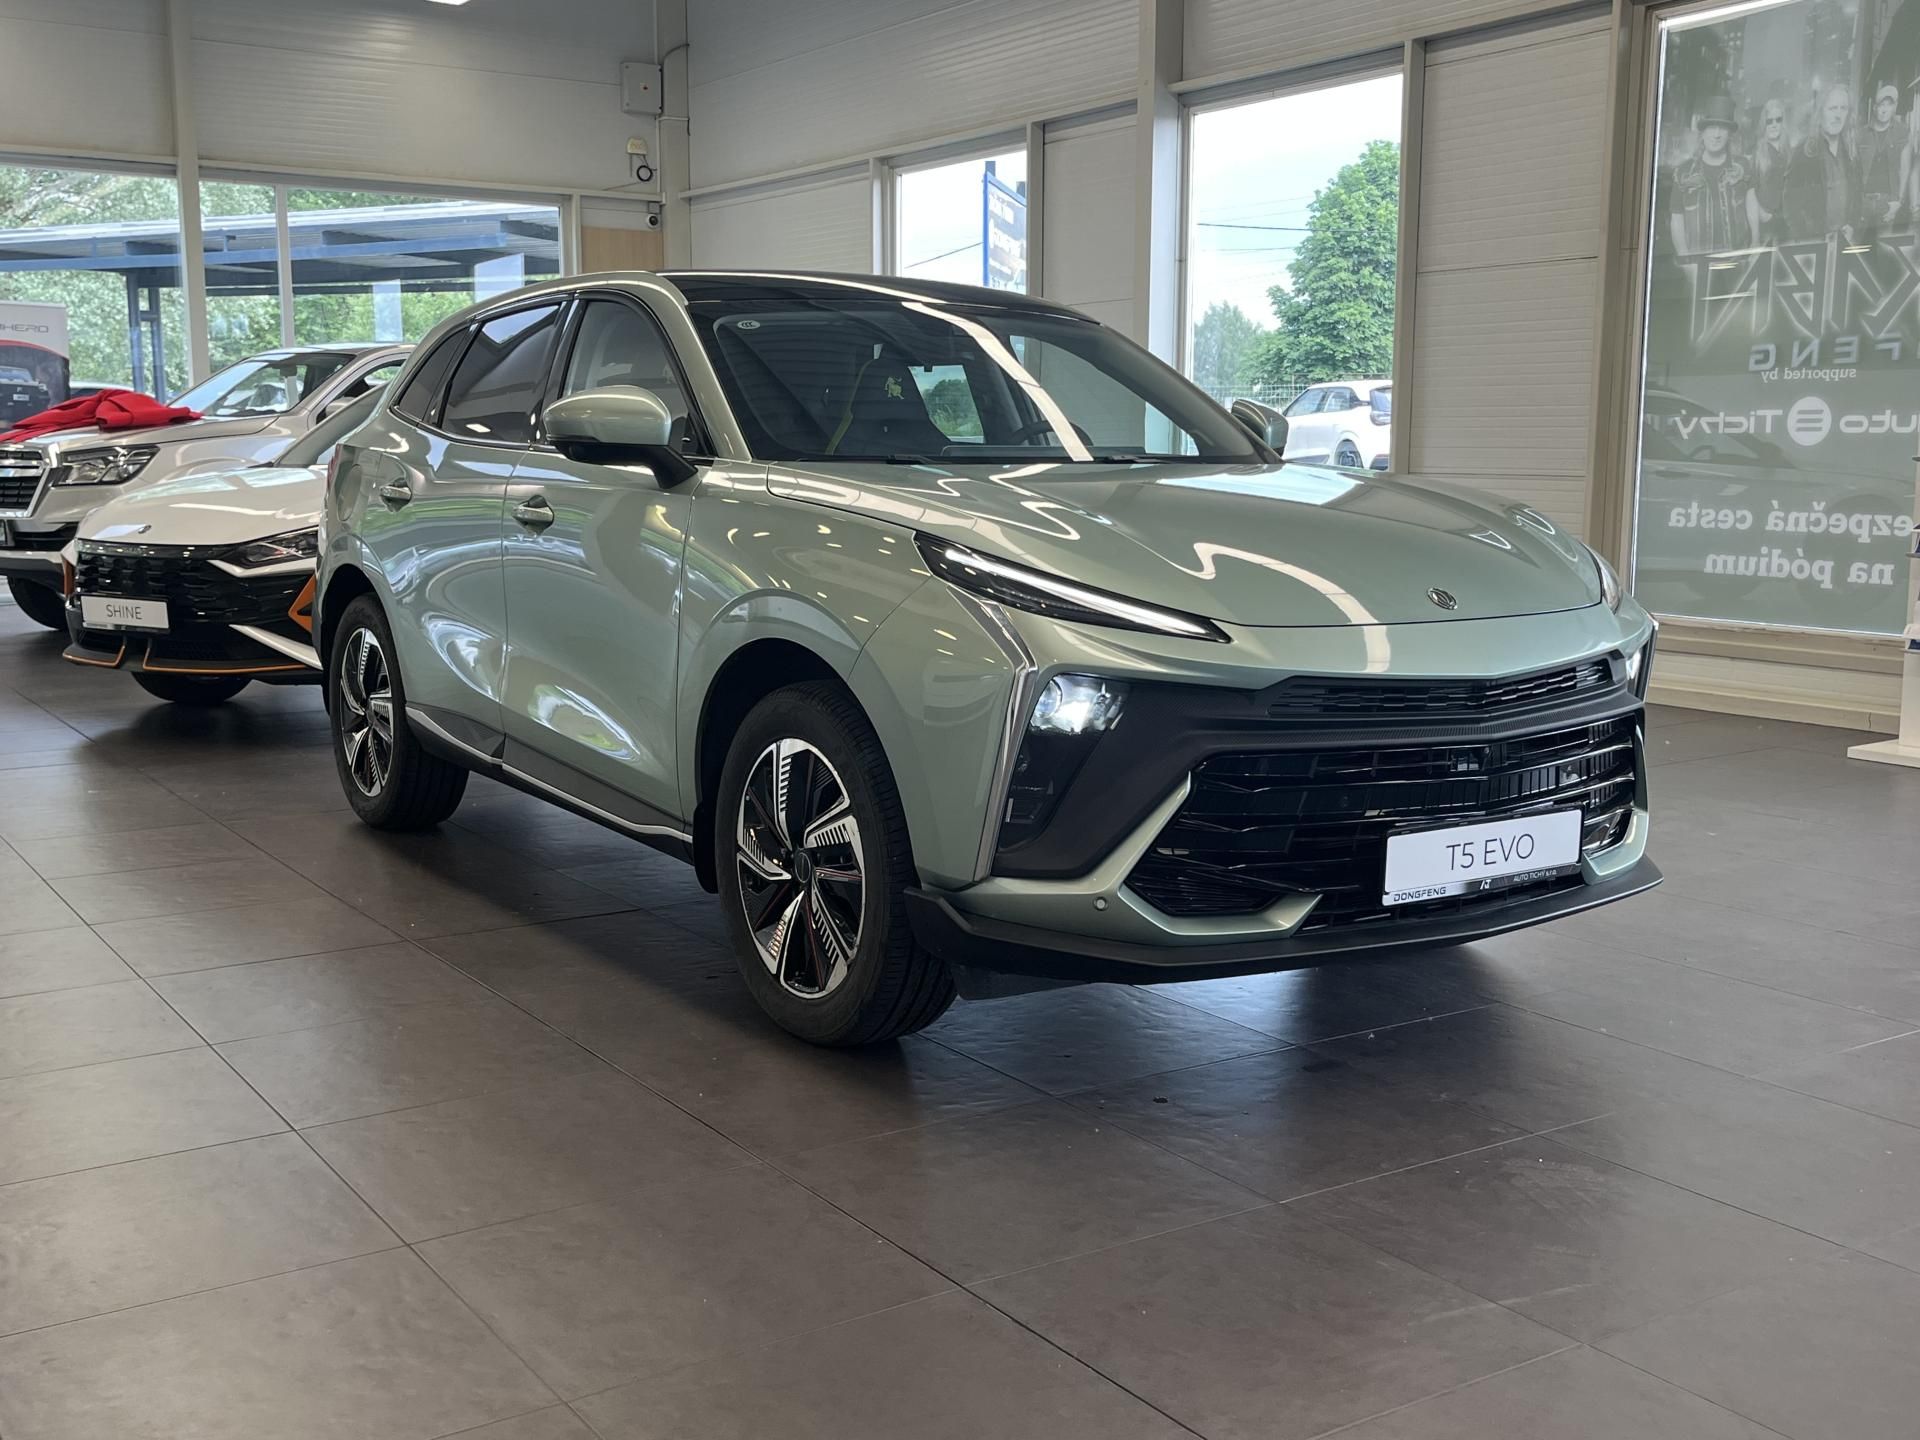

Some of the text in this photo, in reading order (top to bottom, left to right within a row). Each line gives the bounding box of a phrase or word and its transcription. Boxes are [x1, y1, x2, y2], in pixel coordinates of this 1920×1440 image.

[105, 603, 143, 620] SHINE
[1445, 833, 1535, 871] T5 EVO
[1393, 886, 1447, 902] DONGFENG
